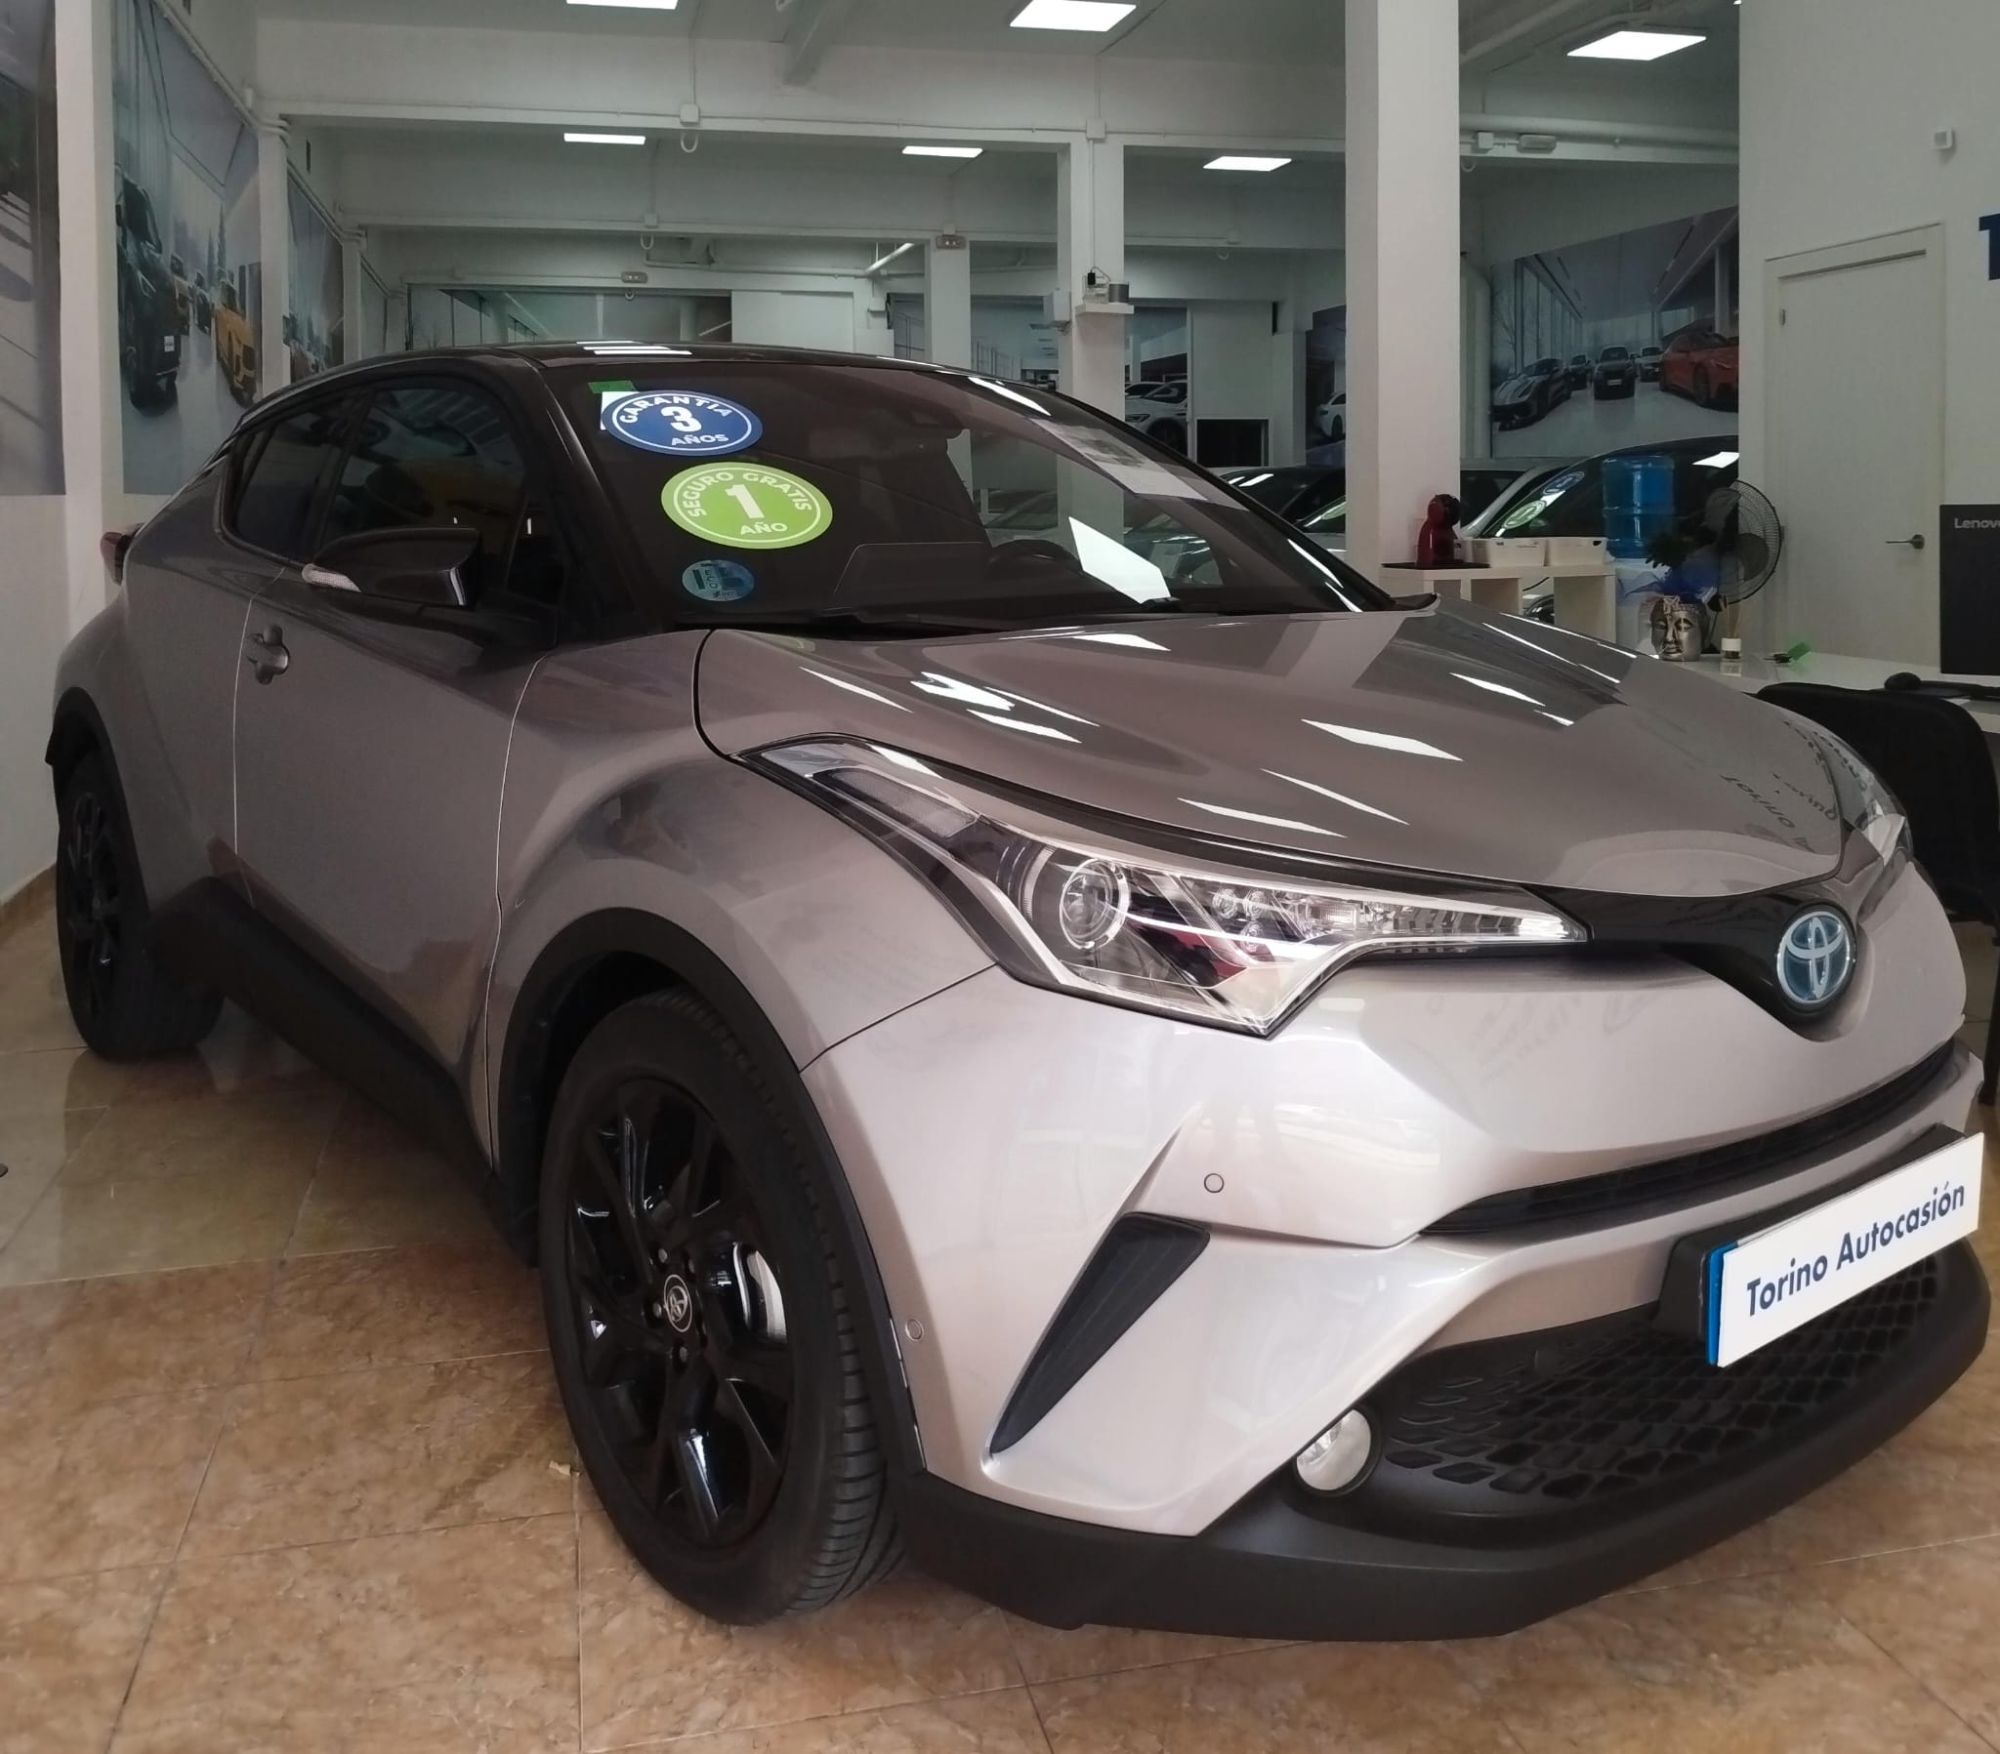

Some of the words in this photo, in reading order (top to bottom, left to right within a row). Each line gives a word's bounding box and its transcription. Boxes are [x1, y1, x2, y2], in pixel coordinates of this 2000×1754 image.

[619, 396, 733, 424] GARANTIA
[660, 406, 702, 432] 3
[671, 434, 729, 446] AÑOS
[682, 471, 735, 518] SEGURO
[742, 472, 812, 511] GRATIS
[724, 484, 765, 519] 1
[740, 521, 788, 536] AÑO
[1954, 517, 2000, 529] Lenov
[1747, 1257, 1828, 1317] Torino
[1836, 1181, 1965, 1271] Autocasión
